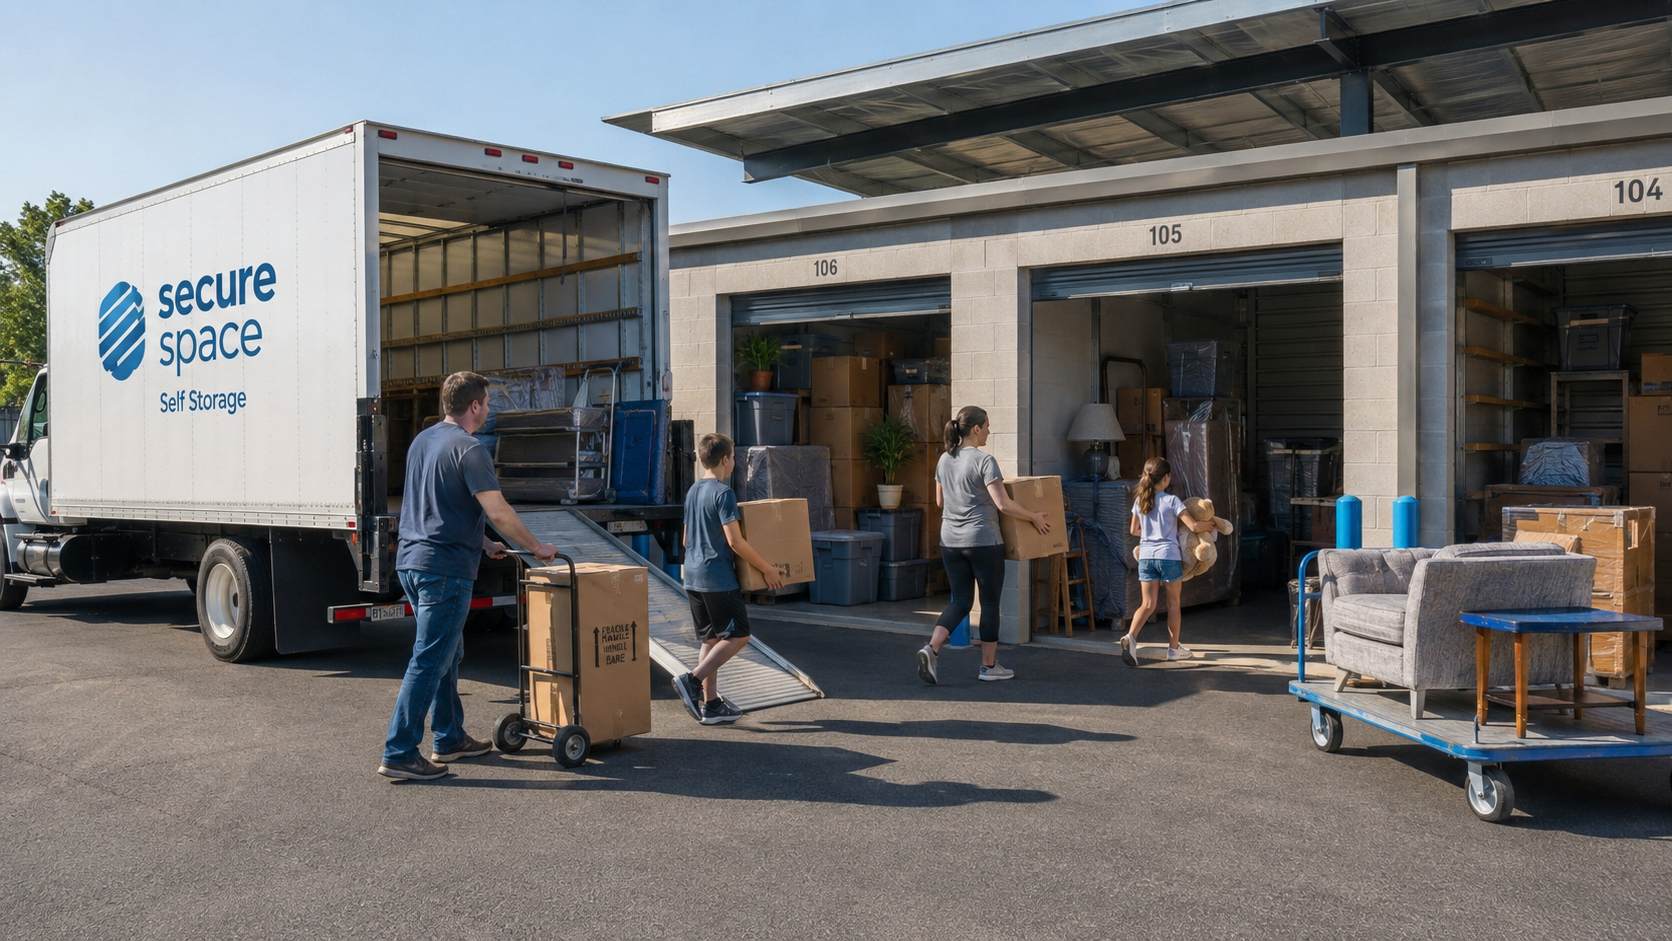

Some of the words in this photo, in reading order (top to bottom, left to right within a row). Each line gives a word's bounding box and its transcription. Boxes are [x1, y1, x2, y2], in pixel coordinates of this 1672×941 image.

[1614, 177, 1663, 204] 104
[1149, 224, 1182, 246] 105
[813, 259, 838, 277] 106
[158, 262, 277, 319] secure
[159, 319, 263, 377] space
[160, 390, 185, 413] Self
[189, 390, 247, 415] Storage
